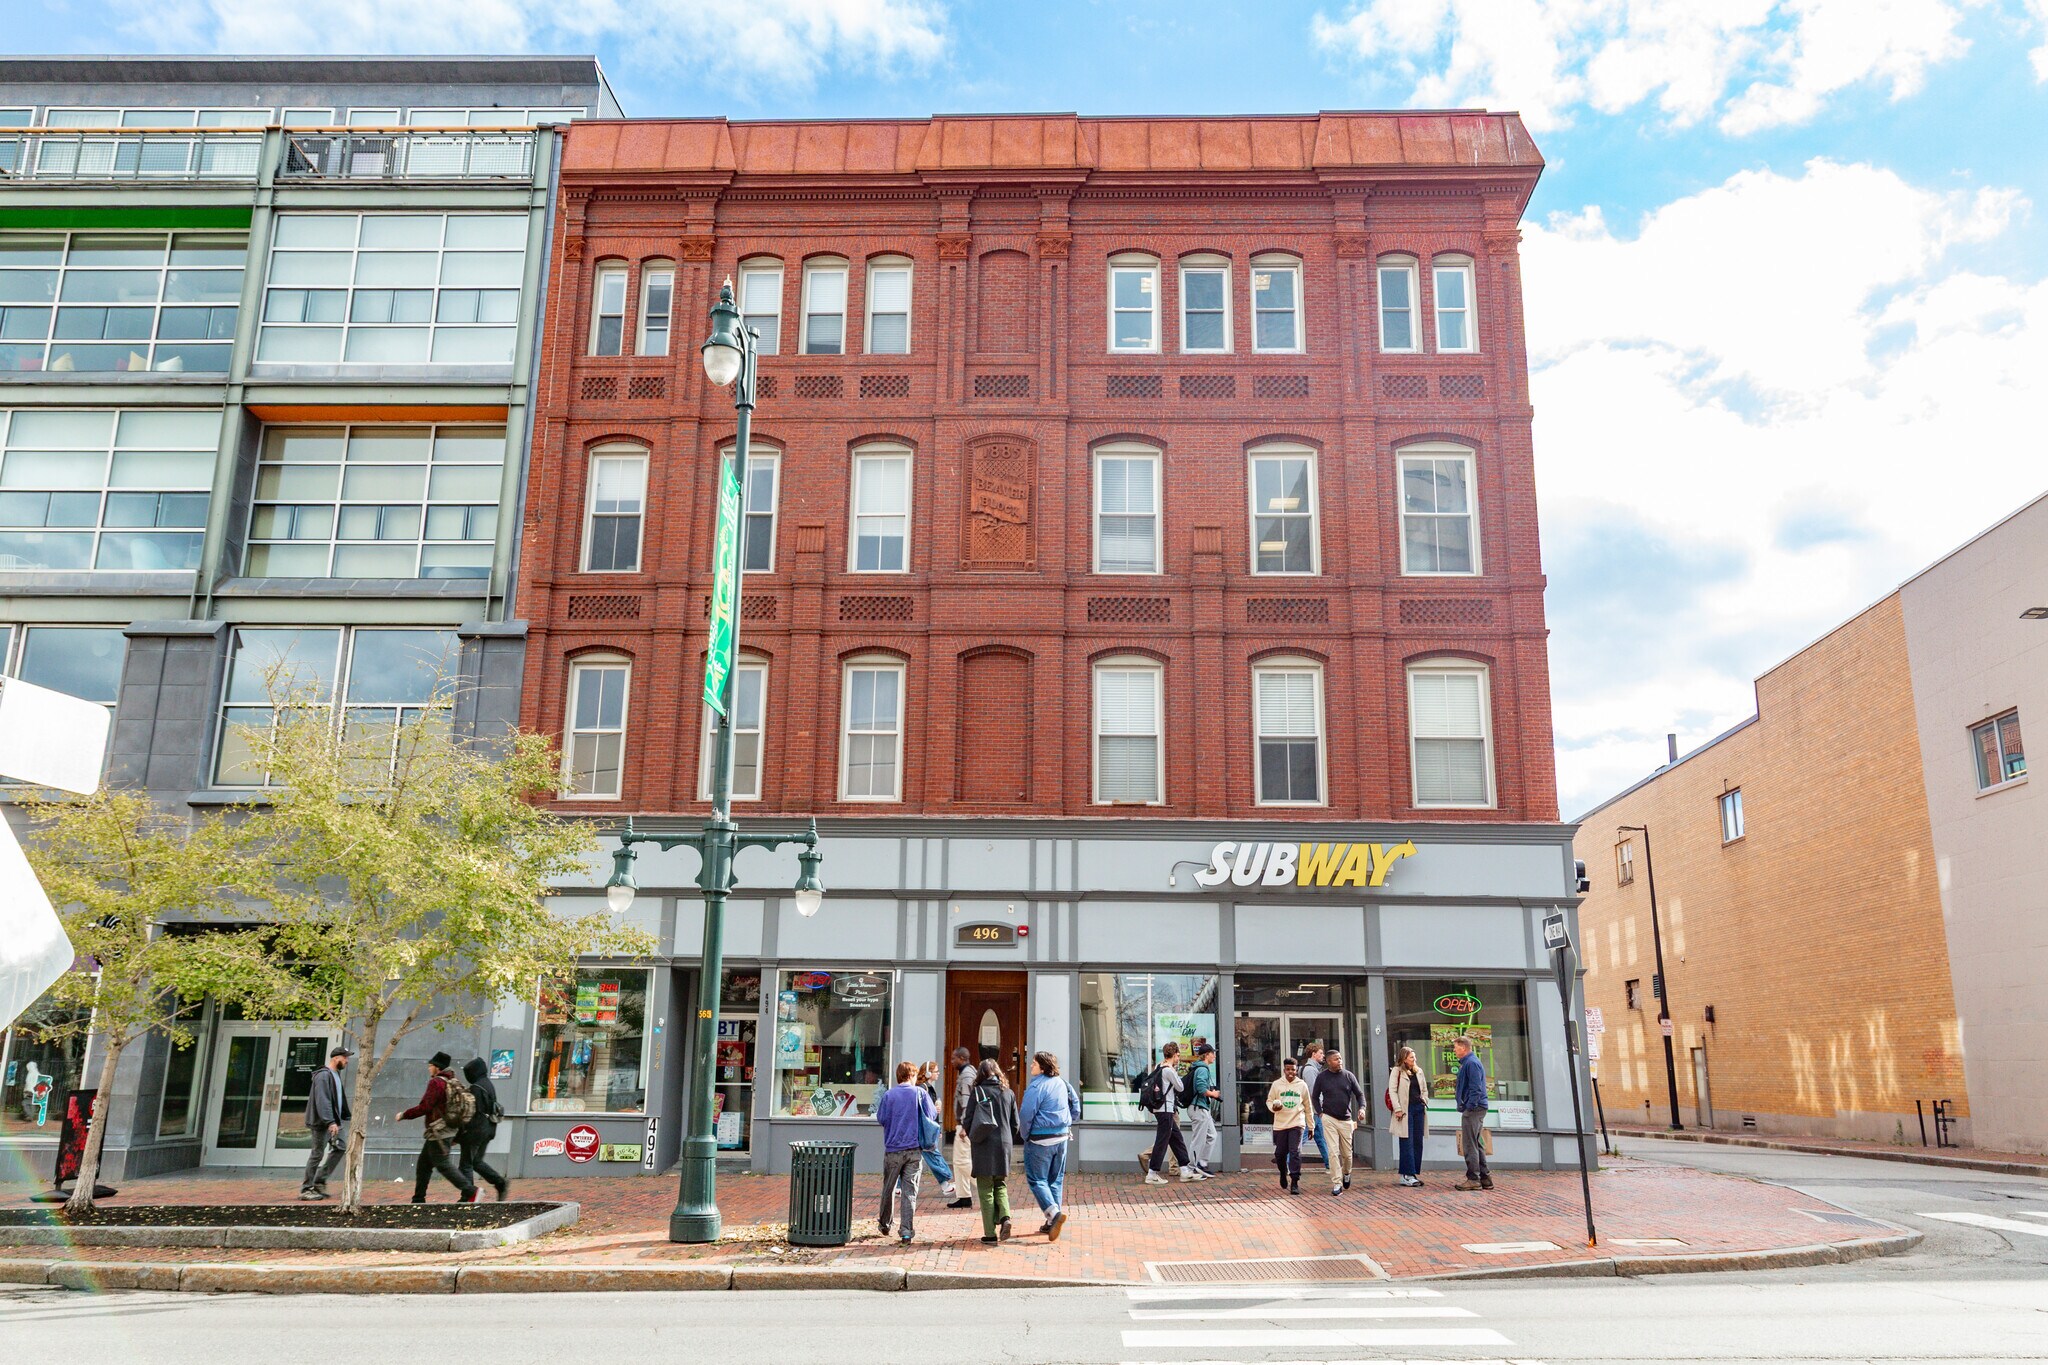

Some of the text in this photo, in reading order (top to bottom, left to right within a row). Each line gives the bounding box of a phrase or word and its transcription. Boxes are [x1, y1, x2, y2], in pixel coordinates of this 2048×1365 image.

[983, 446, 1021, 459] 1885
[976, 479, 1027, 500] BEAVER
[980, 497, 1020, 518] BLOCK
[1192, 839, 1418, 888] SUBWAY
[973, 927, 999, 939] 496
[1440, 998, 1475, 1012] OPEN
[717, 1021, 739, 1035] BT
[535, 1140, 562, 1153] BACKWOODS
[645, 1118, 656, 1168] 494
